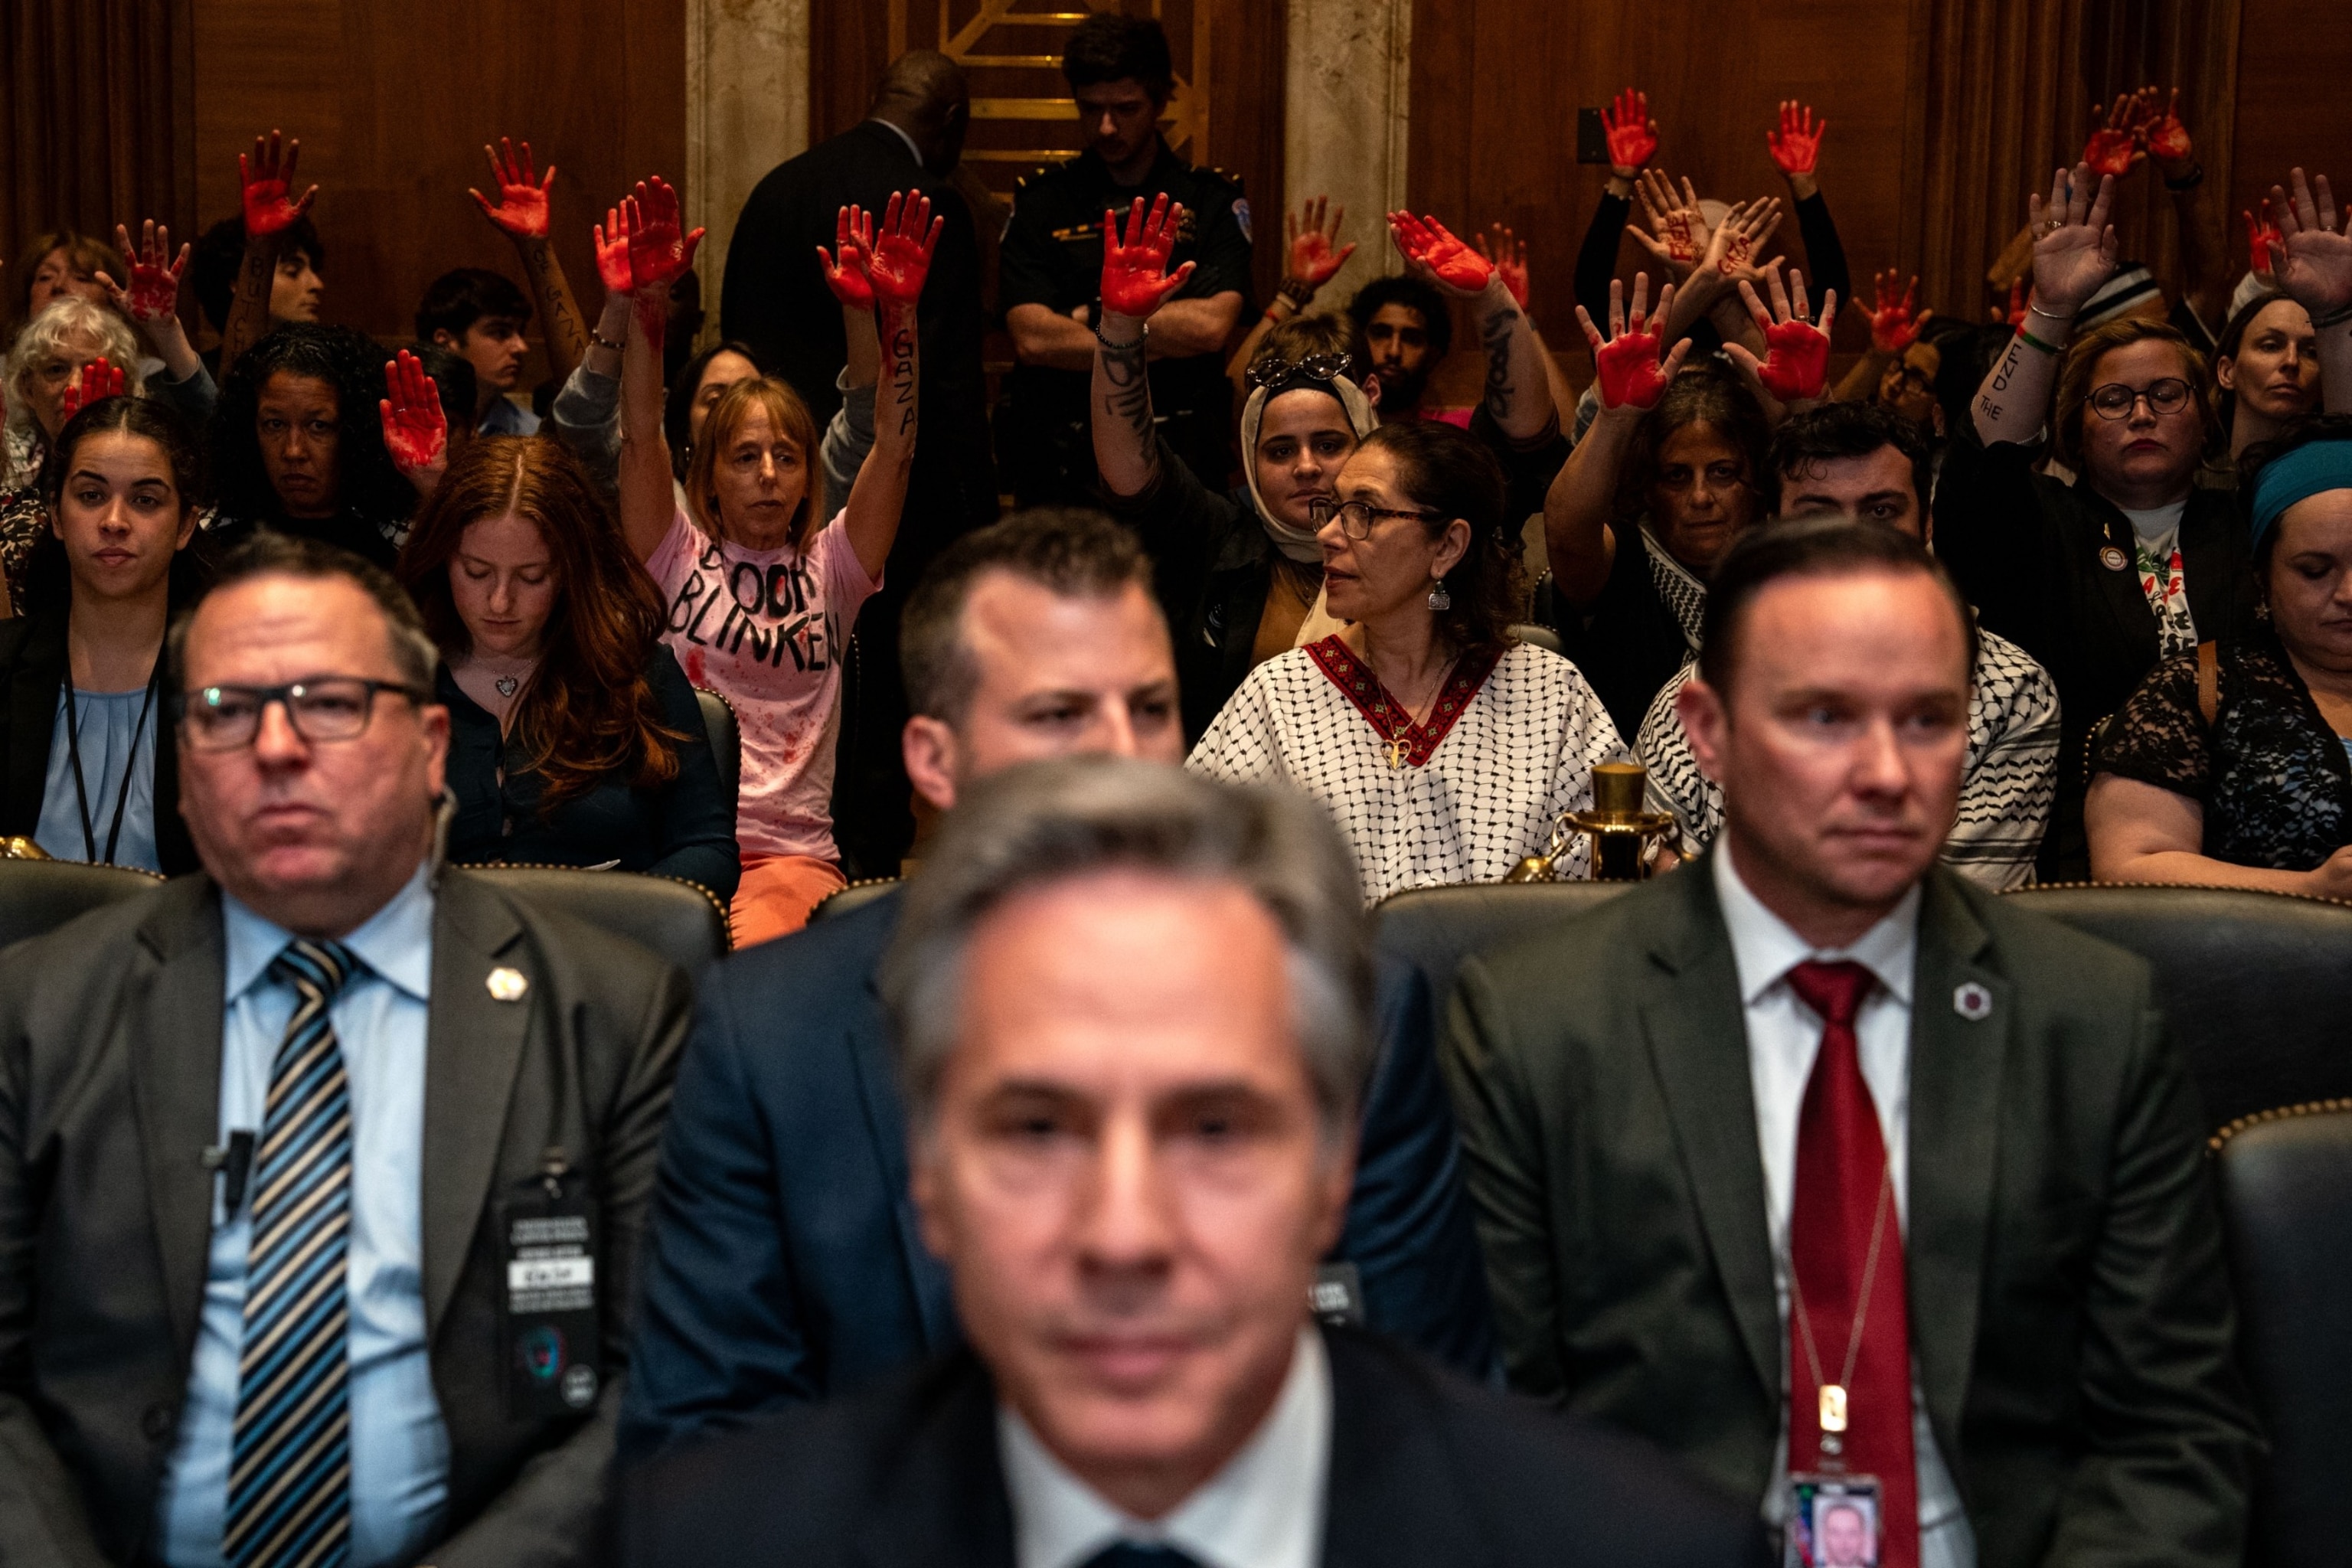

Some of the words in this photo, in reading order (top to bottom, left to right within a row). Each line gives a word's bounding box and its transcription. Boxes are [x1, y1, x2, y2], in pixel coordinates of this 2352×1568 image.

[1718, 237, 1751, 275] GAZA
[534, 249, 549, 274] OF
[545, 285, 585, 356] GAZA
[893, 328, 916, 436] GAZA
[1991, 343, 2022, 391] END
[1980, 394, 2004, 420] THE
[668, 569, 841, 672] BLINKEN
